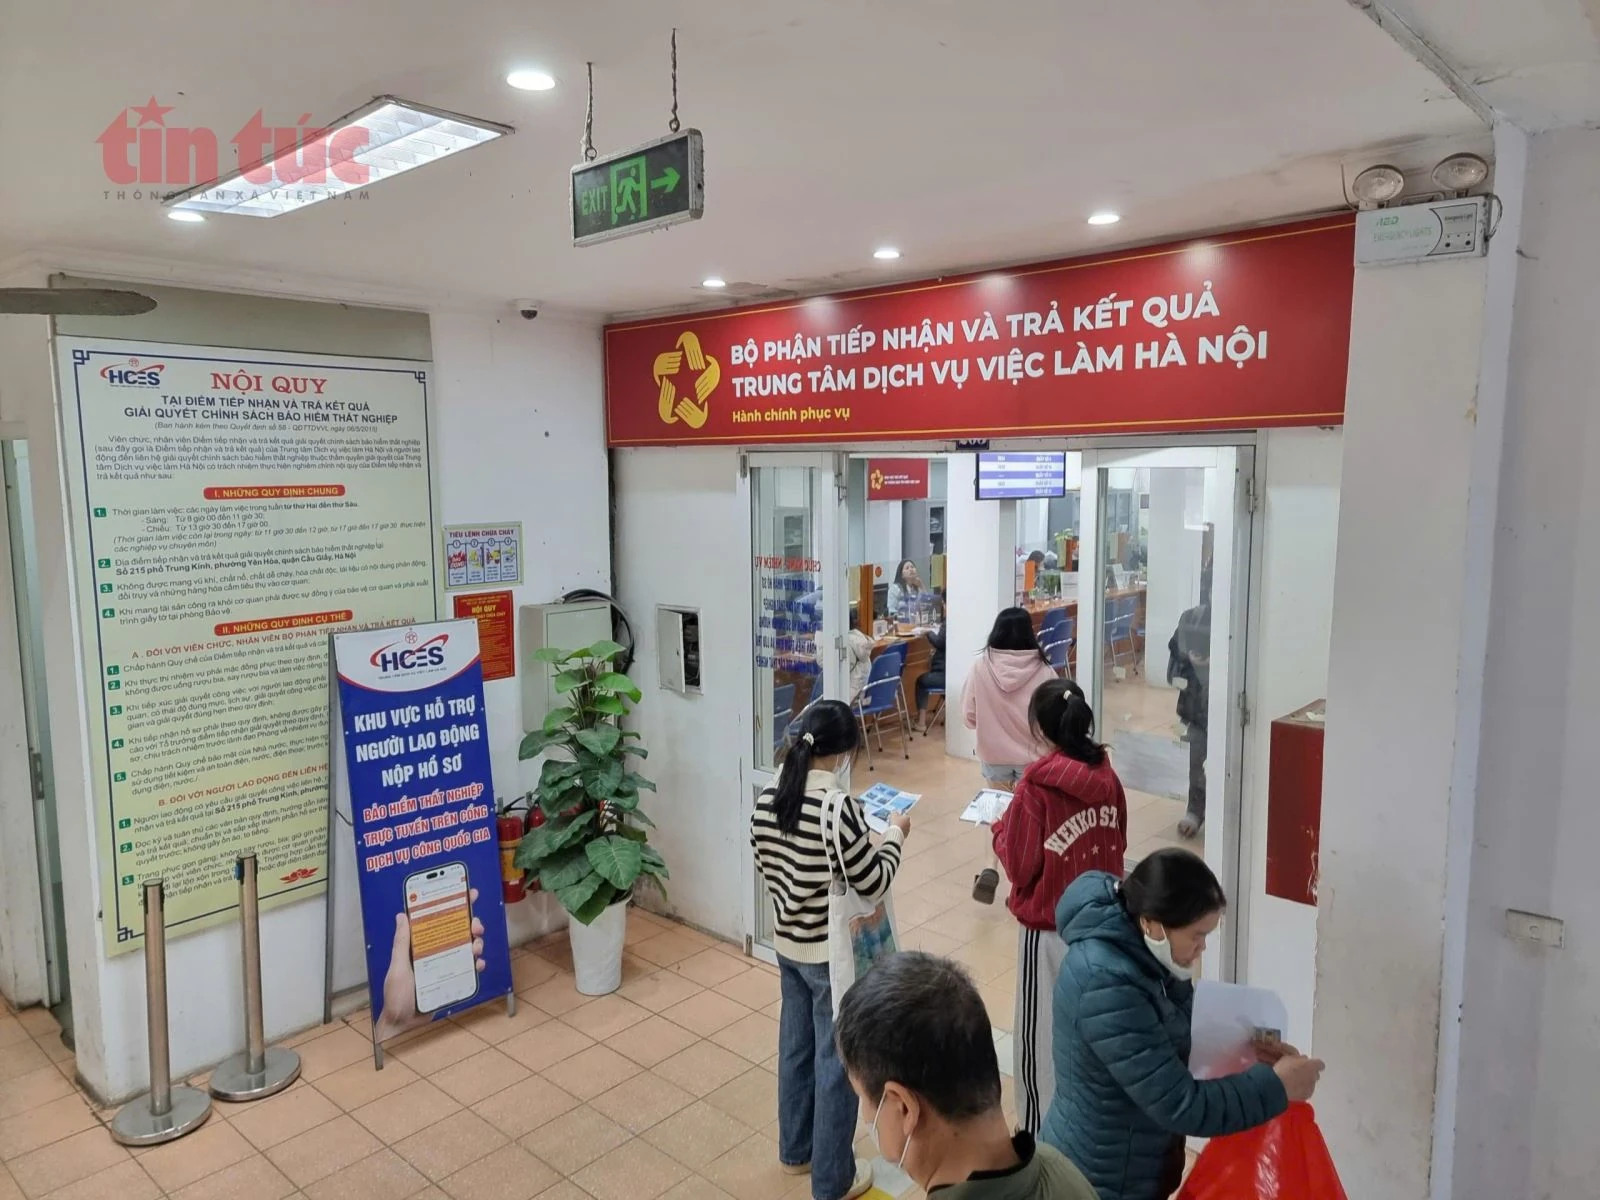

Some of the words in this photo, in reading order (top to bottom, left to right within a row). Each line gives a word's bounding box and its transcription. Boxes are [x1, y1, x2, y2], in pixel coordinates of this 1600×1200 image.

[581, 186, 608, 216] EXIT
[731, 338, 758, 368] BỘ
[764, 333, 821, 364] PHẬN
[827, 324, 875, 355] TIẾP
[883, 319, 953, 352] NHẬN
[961, 311, 999, 342] VÀ
[1006, 301, 1064, 338] TRẢ
[1074, 293, 1133, 331] KẾT
[1142, 280, 1220, 328] QUẢ
[732, 372, 801, 397] TRUNG
[808, 365, 855, 393] TÂM
[863, 363, 923, 393] DỊCH
[931, 358, 969, 389] VỤ
[977, 348, 1044, 386] VIỆC
[1054, 341, 1123, 375] LÀM
[1135, 332, 1187, 369] HÀ
[1198, 325, 1267, 369] NỘI
[109, 370, 160, 386] HCES
[210, 370, 263, 395] NỘI
[271, 376, 327, 394] QUY
[124, 407, 150, 417] GIẢI
[154, 407, 197, 418] QUYẾT
[201, 408, 238, 419] CHÍNH
[242, 409, 273, 420] SÁCH
[277, 410, 300, 420] BẢO
[304, 411, 329, 421] HIỂM
[332, 411, 358, 422] THẤT
[361, 412, 397, 424] NGHIỆP
[732, 409, 761, 423] Hành
[764, 407, 796, 421] chính
[800, 406, 831, 422] phục
[834, 407, 850, 421] vụ
[223, 488, 257, 497] NHỮNG
[283, 488, 304, 498] ĐỊNH
[234, 619, 267, 632] NHỮNG
[271, 619, 288, 628] QUY
[292, 616, 312, 627] ĐỊNH
[316, 614, 326, 624] CỤ
[330, 612, 347, 622] THỂ
[381, 646, 444, 672] HCES
[354, 712, 386, 731] KHU
[390, 706, 420, 726] VỰC
[424, 696, 444, 719] HỖ
[448, 694, 475, 718] TRỢ
[356, 736, 404, 761] NGƯỜI
[408, 732, 436, 751] LAO
[440, 724, 479, 745] ĐỘNG
[382, 764, 413, 786] NỘP
[418, 755, 438, 778] HỒ
[442, 753, 461, 773] SƠ
[362, 803, 387, 822] BẢO
[388, 795, 418, 814] HIỂM
[418, 789, 444, 808] THẤT
[445, 782, 484, 802] NGHIỆP
[363, 828, 393, 848] TRỰC
[395, 816, 431, 838] TUYẾN
[431, 809, 458, 831] TRÊN
[459, 803, 489, 823] CỔNG
[365, 849, 394, 872] DỊCH
[395, 847, 411, 865] VỤ
[411, 840, 441, 858] CÔNG
[442, 829, 471, 851] QUỐC
[472, 827, 490, 842] GIA
